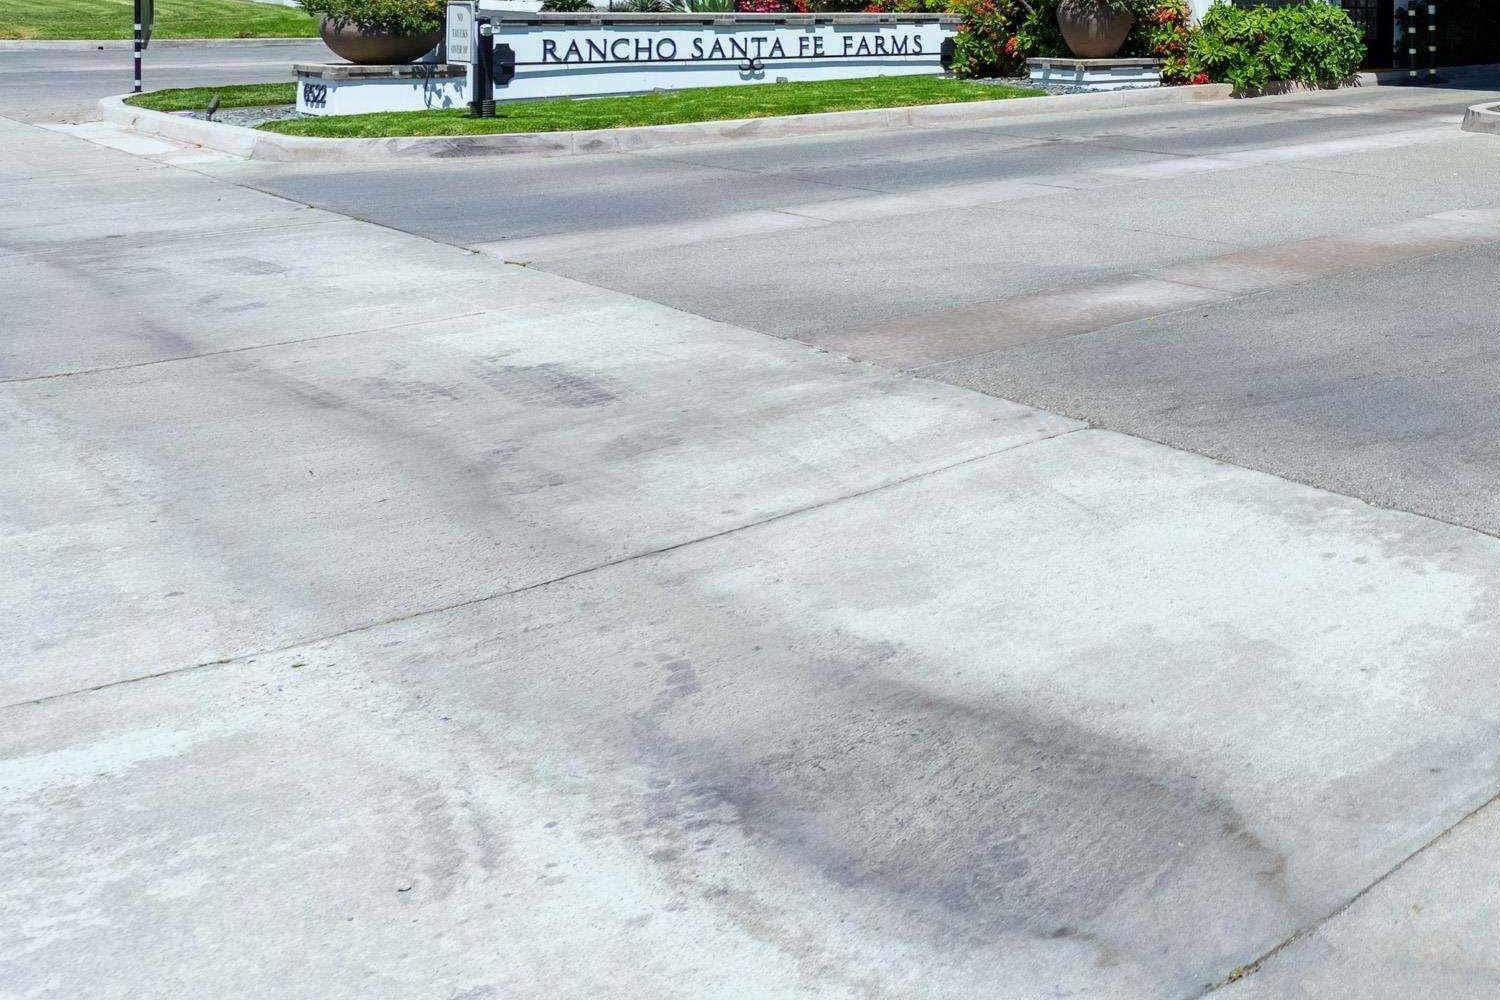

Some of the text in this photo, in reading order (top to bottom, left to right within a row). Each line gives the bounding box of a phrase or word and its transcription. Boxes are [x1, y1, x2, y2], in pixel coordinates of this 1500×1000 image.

[543, 34, 923, 62] RANCHO SANTA FE FARMS
